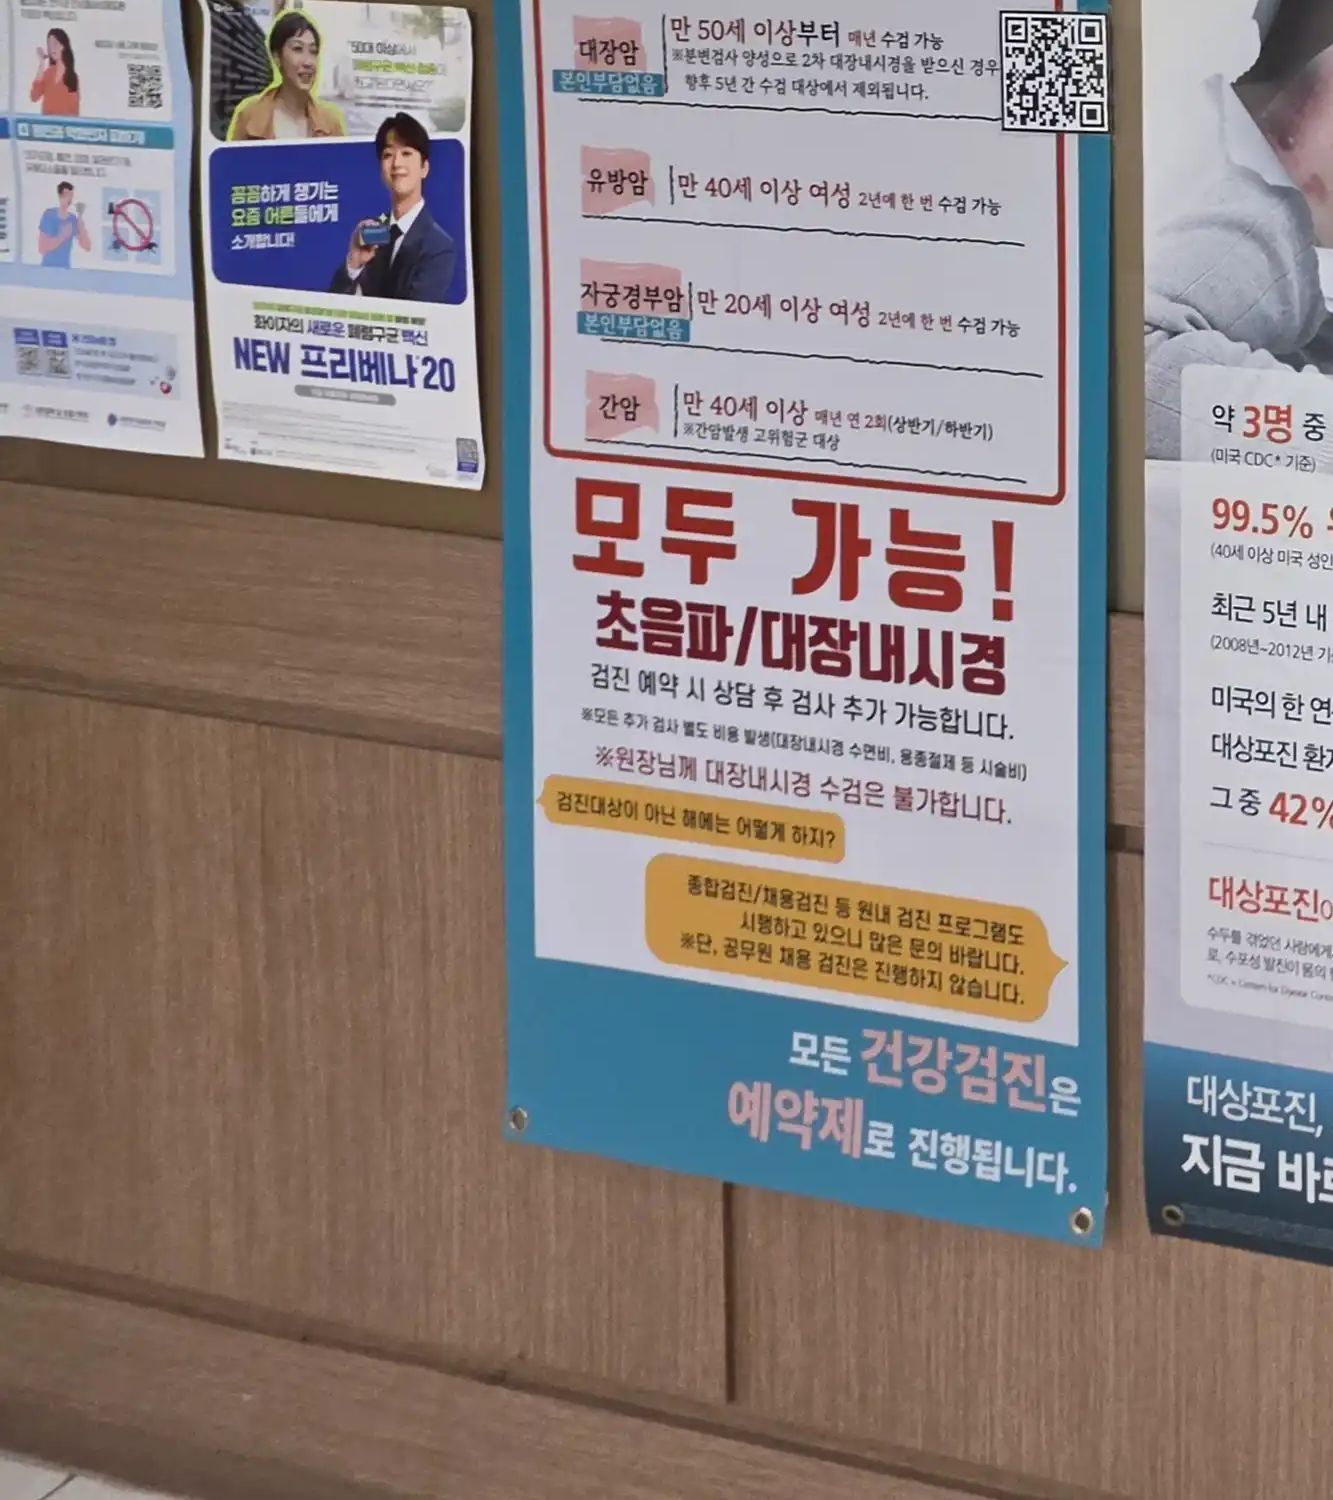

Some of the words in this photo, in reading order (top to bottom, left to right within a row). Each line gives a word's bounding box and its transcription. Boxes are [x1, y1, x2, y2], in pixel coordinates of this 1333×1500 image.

[579, 39, 639, 65] 대장암
[559, 71, 657, 93] 본인부담없음
[587, 169, 649, 197] 유방암
[581, 281, 684, 313] 자궁경부암
[583, 314, 683, 339] 본인부담없음
[233, 337, 291, 375] NEW
[599, 395, 640, 421] 간암
[1212, 404, 1235, 433] 약
[1242, 404, 1293, 443] 3명
[1303, 413, 1326, 442] 중
[1211, 497, 1314, 540] 99.5%
[573, 477, 737, 585] 모두
[791, 498, 1015, 621] 가능!
[1212, 592, 1256, 623] 최근
[1263, 600, 1298, 628] 5년
[1306, 604, 1326, 632] 내
[596, 590, 1006, 696] 초음파/대장내시경
[1212, 733, 1298, 769] 대상포진
[790, 1032, 851, 1076] 모든
[861, 1028, 1081, 1117] 건강검진은
[1187, 1075, 1324, 1137] 대상포진,
[728, 1080, 895, 1159] 예약제로
[908, 1129, 1077, 1193] 진행됩니다.
[1182, 1134, 1265, 1193] 지금
